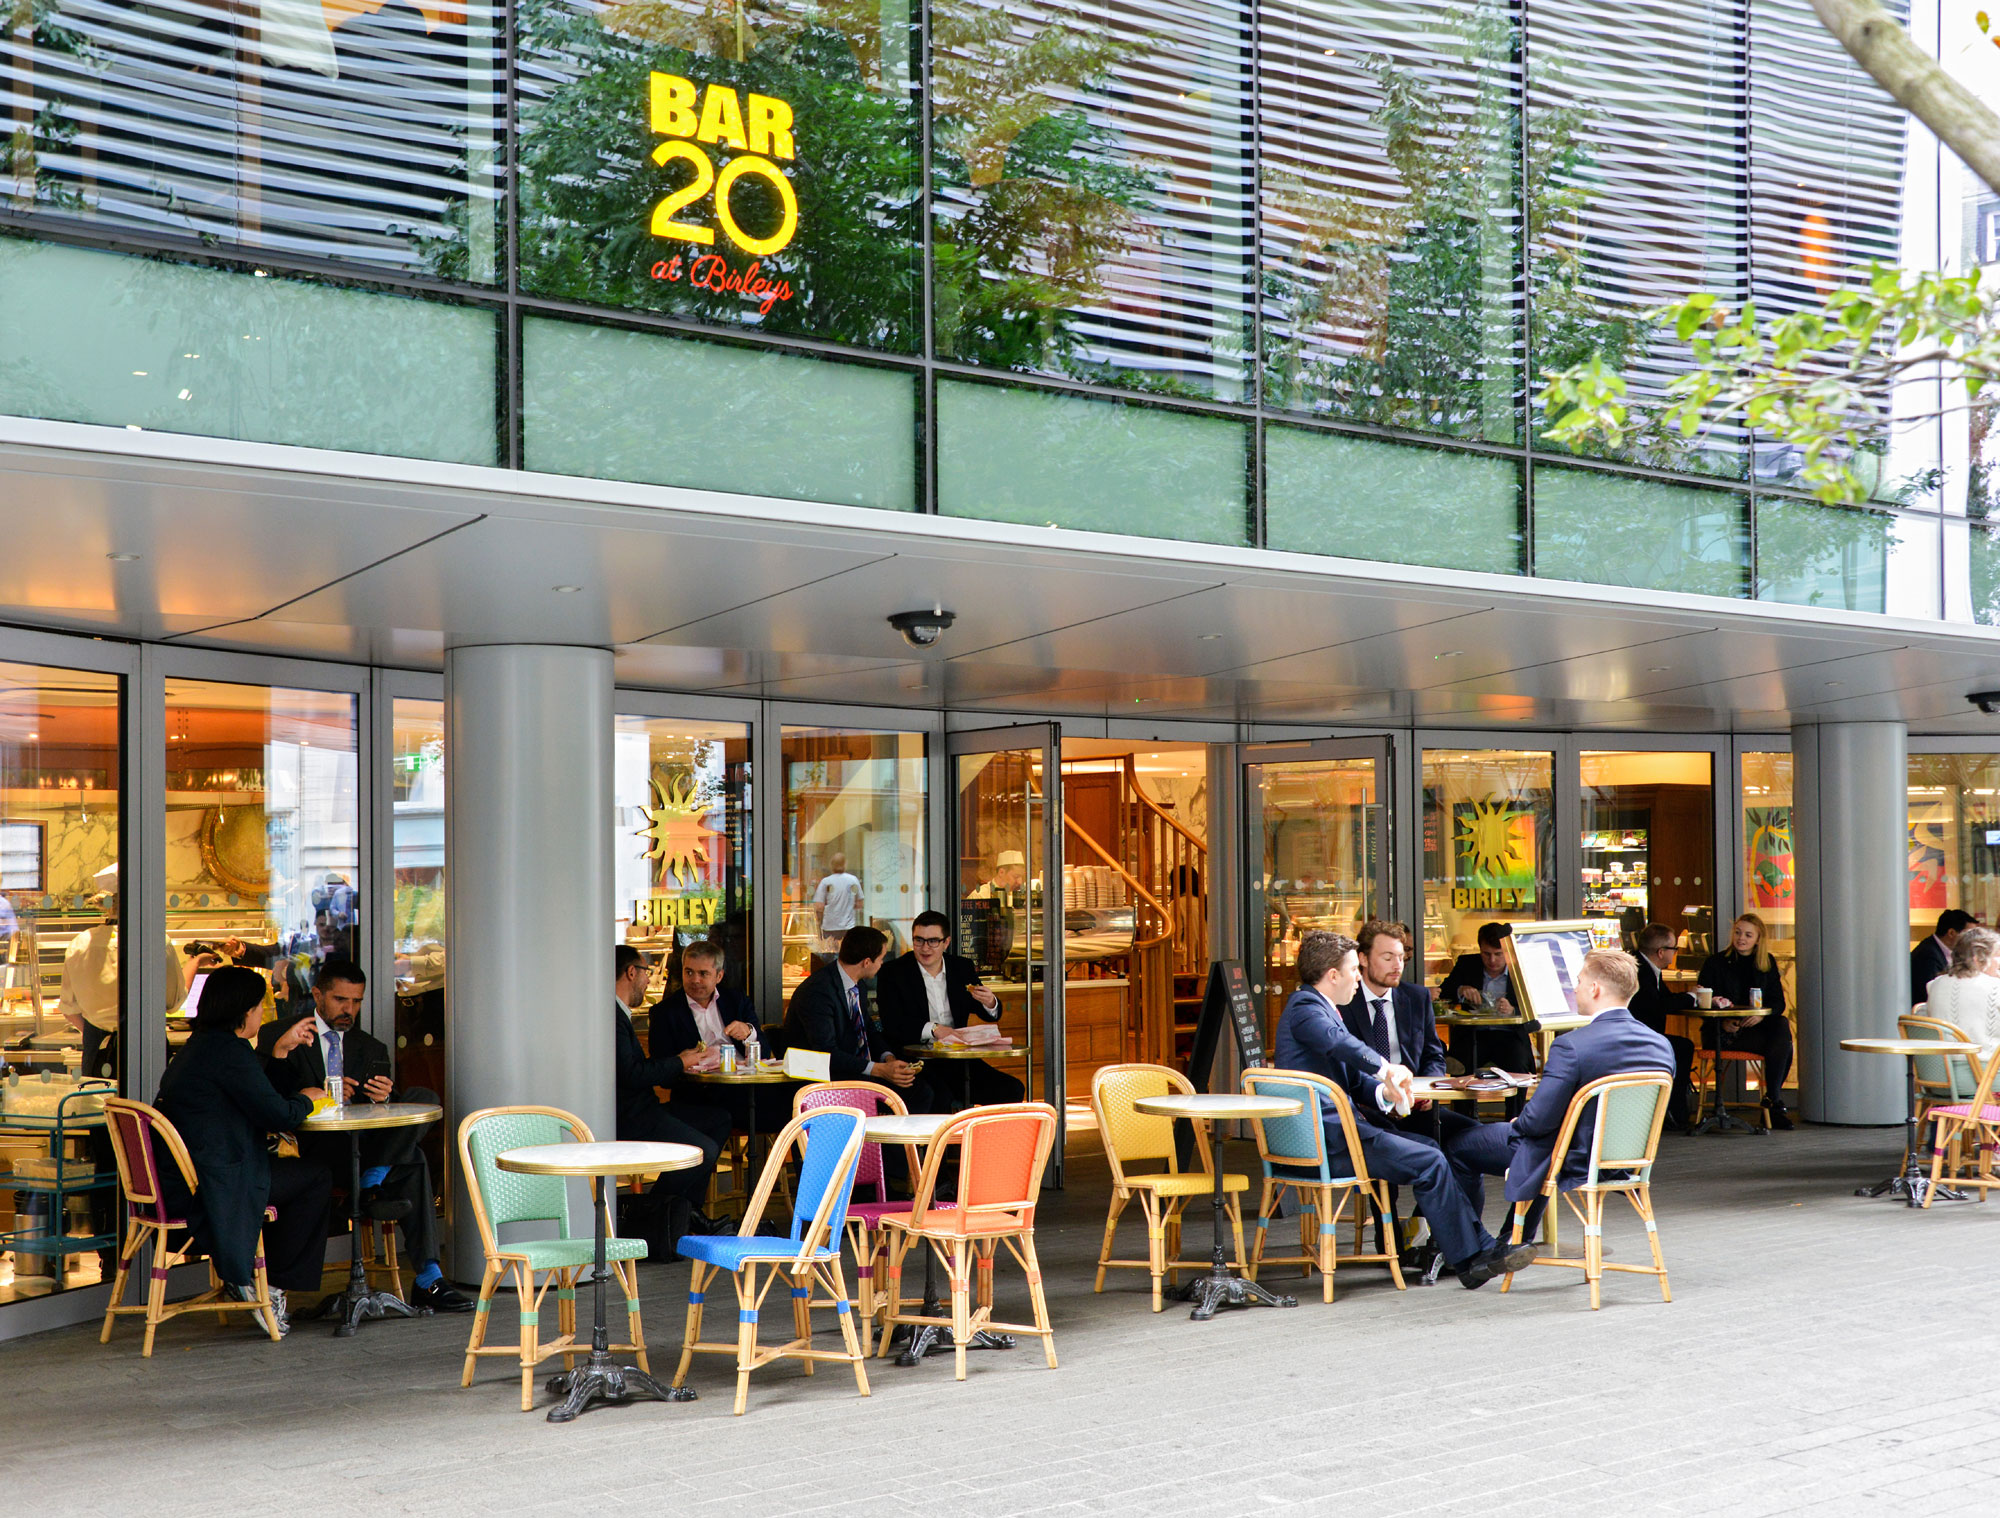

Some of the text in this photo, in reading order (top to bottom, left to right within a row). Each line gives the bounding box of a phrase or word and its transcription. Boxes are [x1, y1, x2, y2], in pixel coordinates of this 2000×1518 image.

[650, 70, 795, 160] BAR
[650, 140, 798, 255] 20
[650, 254, 794, 315] at Birleys
[635, 898, 718, 926] BIRLEY
[1453, 888, 1527, 909] BIRLEY
